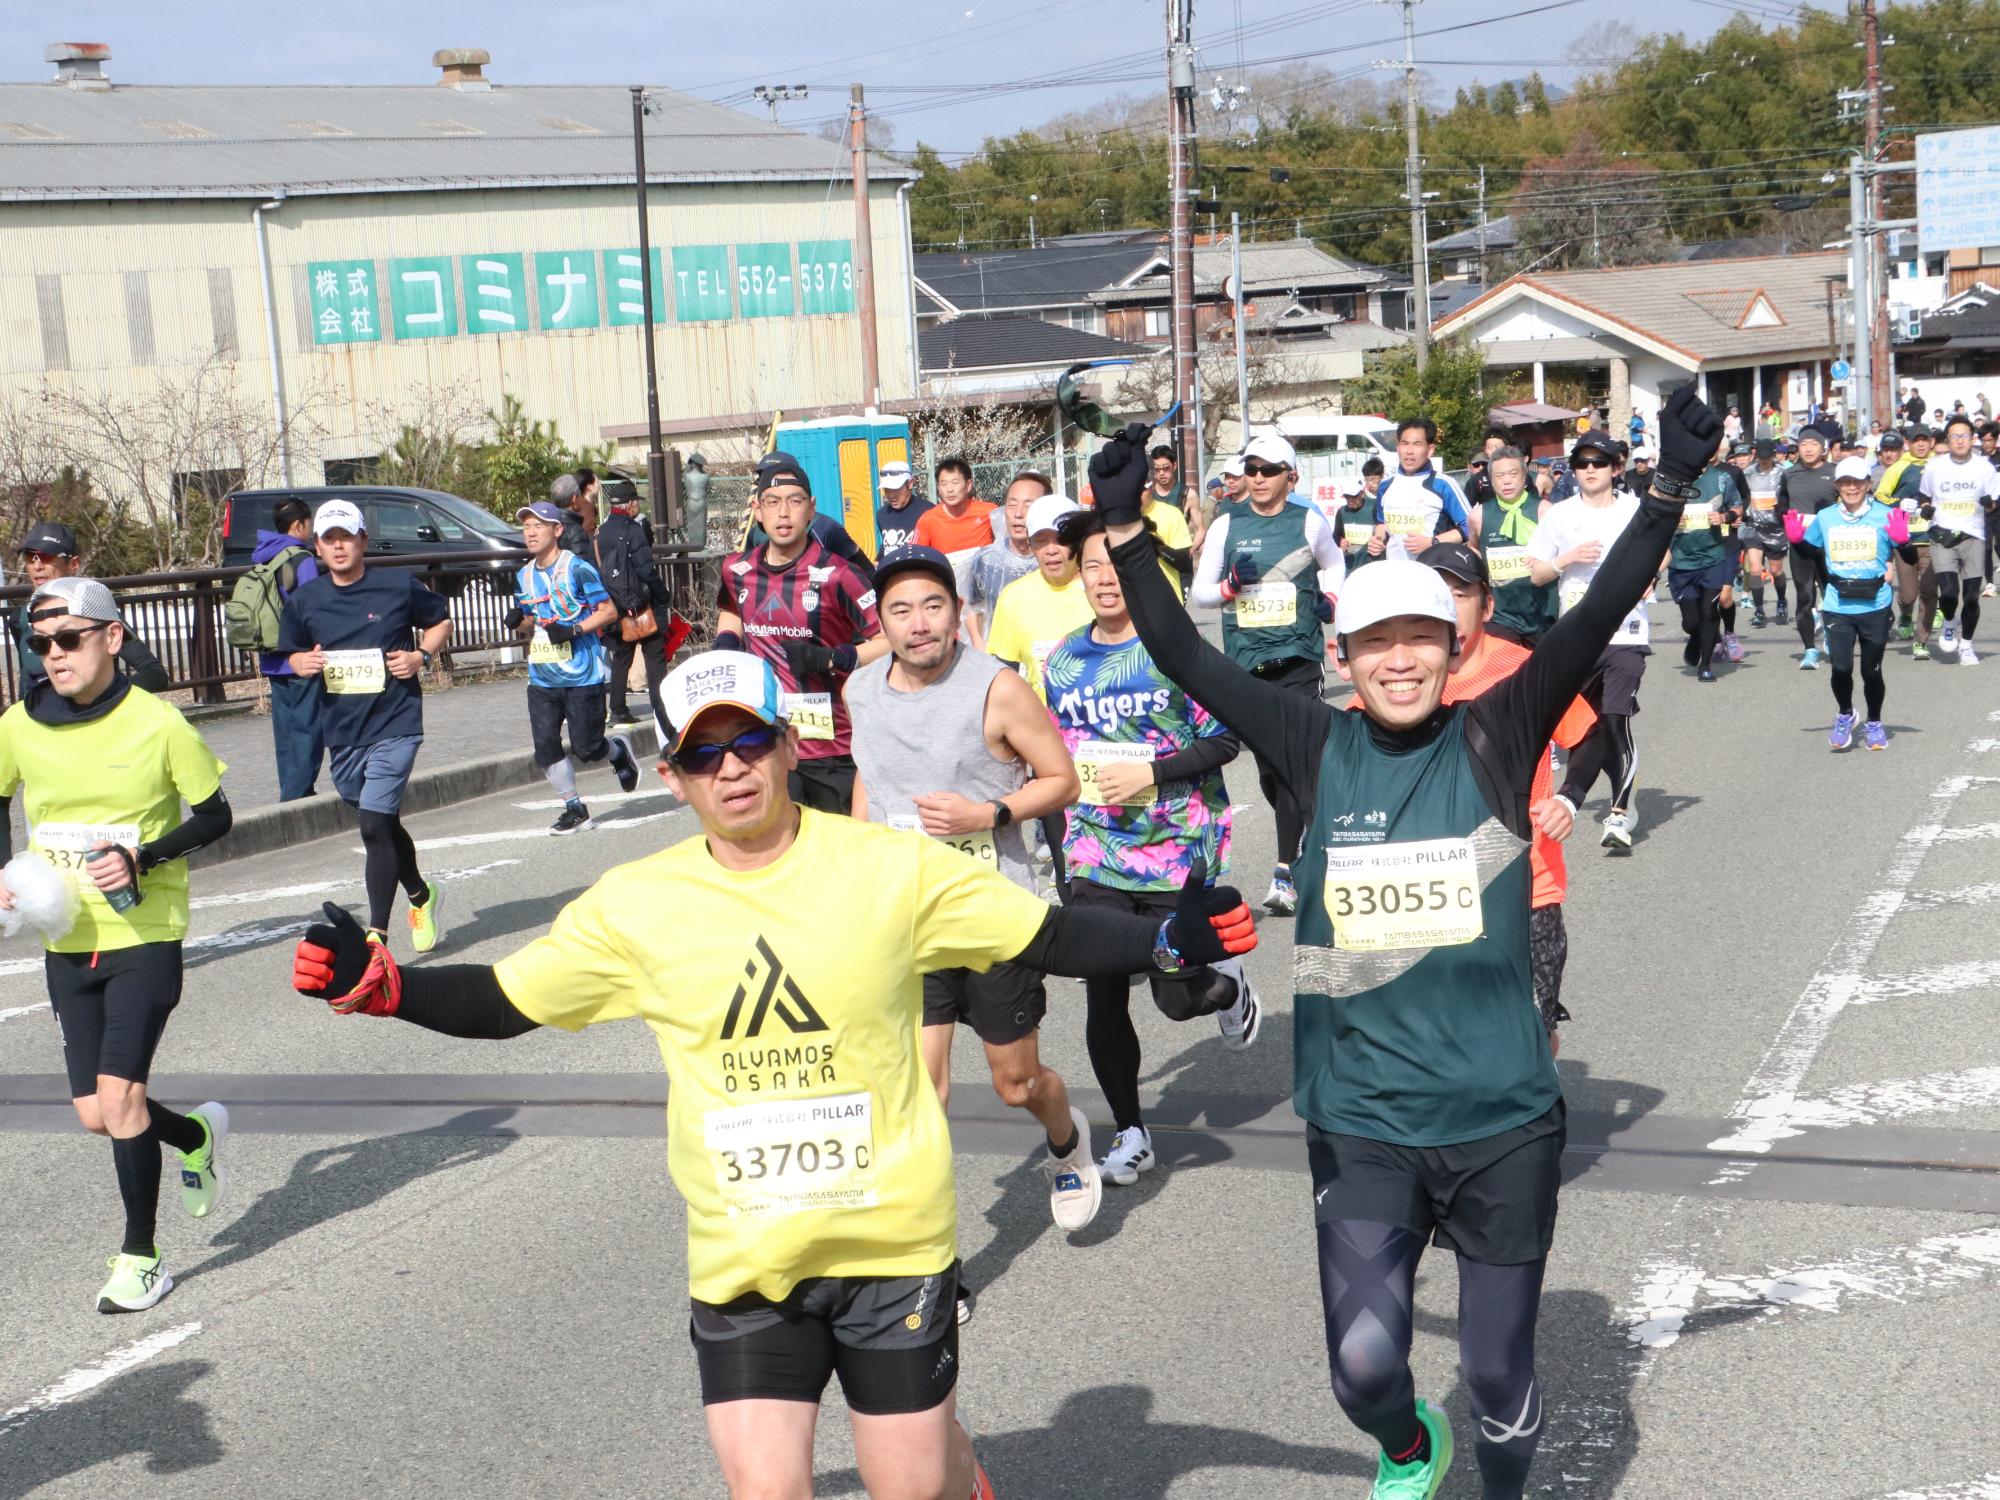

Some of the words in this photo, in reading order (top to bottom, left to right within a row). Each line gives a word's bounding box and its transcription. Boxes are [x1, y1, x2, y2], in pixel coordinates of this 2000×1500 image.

[315, 268, 369, 298] 株式
[401, 257, 644, 325] コミナミ
[677, 269, 726, 296] TEL
[738, 262, 854, 296] 552-5373
[319, 306, 374, 335] 会社
[1386, 514, 1416, 524] 37236
[1831, 540, 1867, 551] 33839
[1240, 600, 1285, 614] 34573
[743, 622, 780, 636] Rakuten
[780, 625, 813, 638] Mobile
[328, 665, 373, 680] 33479
[686, 664, 736, 686] KOBE
[686, 677, 736, 692] MARATHON
[686, 680, 736, 706] 2012
[1058, 685, 1171, 733] Tigers
[821, 716, 830, 727] C
[1121, 749, 1151, 757] PILLAR
[97, 831, 133, 841] PILLAR
[980, 844, 992, 860] C
[1371, 856, 1412, 867] 株式会社
[1416, 848, 1468, 864] PILLAR
[1334, 880, 1448, 917] 33055
[1457, 886, 1473, 909] C
[722, 1045, 834, 1071] ALVAMOS
[725, 1064, 836, 1093] OSAKA
[812, 1104, 864, 1121] PILLAR
[721, 1138, 846, 1183] 33703
[855, 1144, 869, 1169] C
